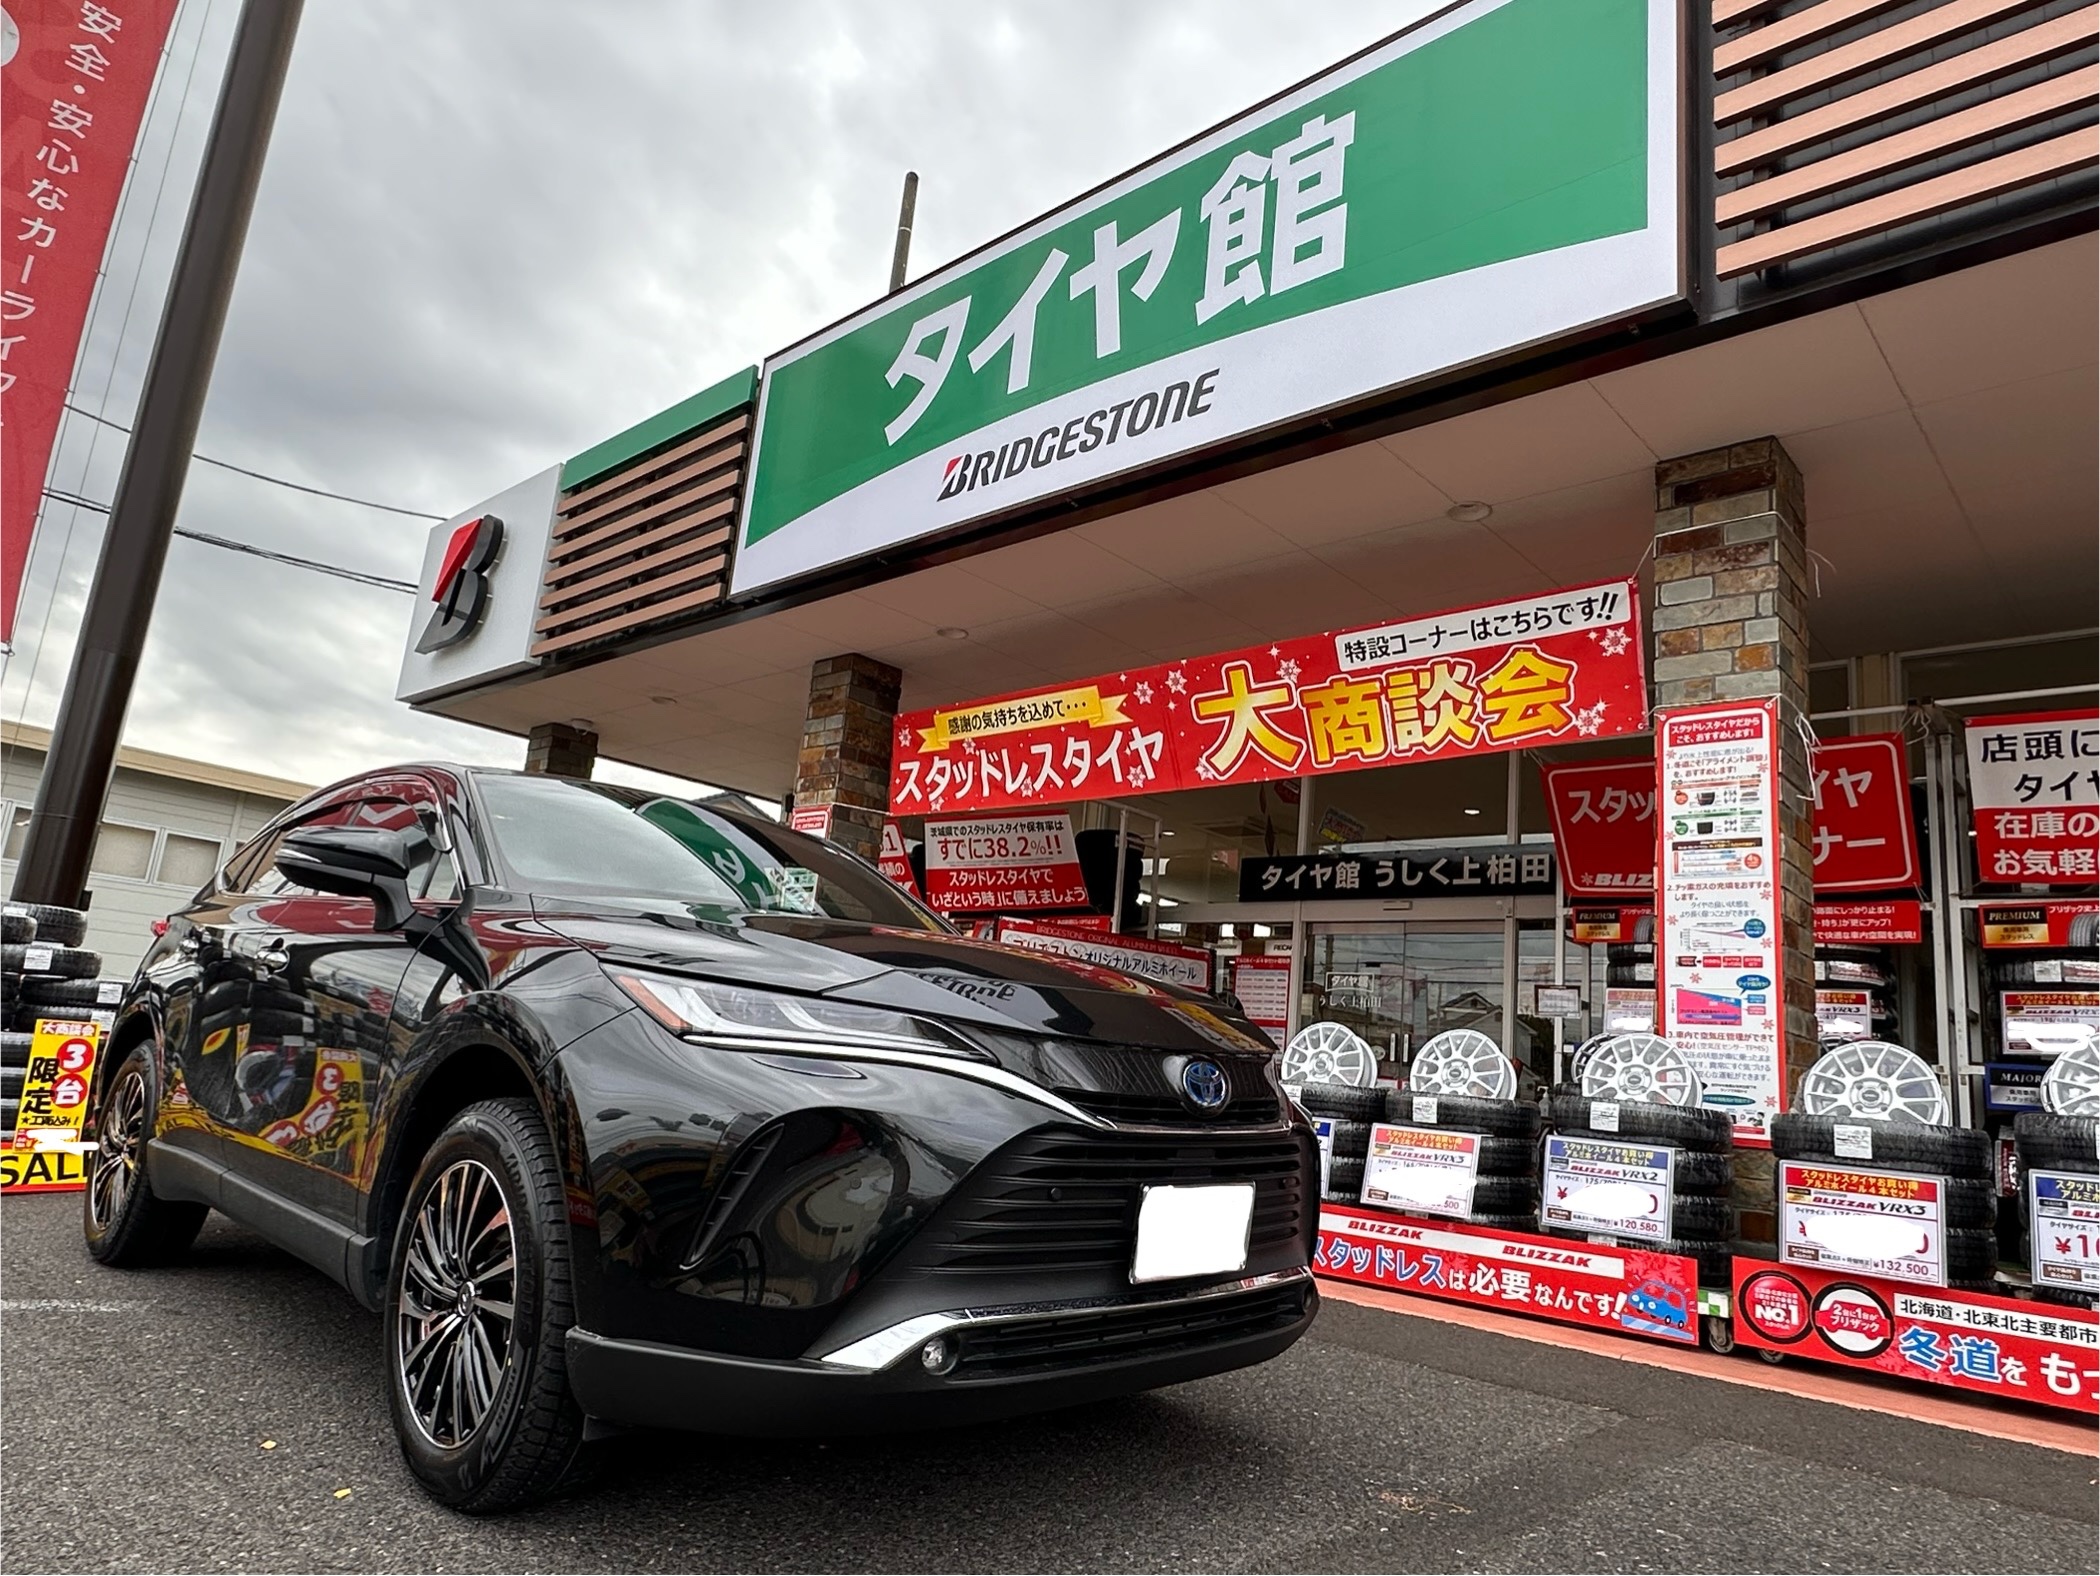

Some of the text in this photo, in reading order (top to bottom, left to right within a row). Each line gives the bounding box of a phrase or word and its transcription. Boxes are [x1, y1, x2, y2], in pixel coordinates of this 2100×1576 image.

[0, 1, 122, 426] 安全・安心なカーライフ
[884, 109, 1356, 446] タイヤ館
[937, 368, 1219, 502] BRIDGESTONE
[1343, 591, 1620, 664] 特設コーナーはこちらです!!
[1192, 645, 1577, 779] 大商談会
[1671, 717, 1760, 734] スタッドレスタイヤだから
[1981, 729, 2099, 763] 店頭に
[895, 728, 1165, 805] スタッドレスタイヤ
[930, 820, 1064, 837] 茨城県でのスタッドレスタイヤ保有率は
[1994, 811, 2099, 840] 在庫の
[938, 834, 1063, 861] すでに38.2%!!
[1262, 853, 1551, 891] タイヤ館 うしく上柏田
[1993, 849, 2099, 877] お気軽
[949, 868, 1054, 887] スタッドレスタイヤで
[1989, 911, 2040, 921] PREMIUM
[22, 1057, 61, 1115] 限定
[1391, 1150, 1465, 1163] BLIZZAK VRX3
[1570, 1165, 1658, 1181] BLIZZAK VRX2
[1801, 1170, 1919, 1191] スタッドレスタイヤお買い得
[1812, 1196, 1877, 1210] BLIZZAK
[1878, 1202, 1927, 1216] VRX3
[1348, 1220, 1422, 1241] BLIZZAK
[1501, 1245, 1592, 1269] BLIZZAK
[1900, 1298, 2098, 1345] 北海道・北東北主要都市
